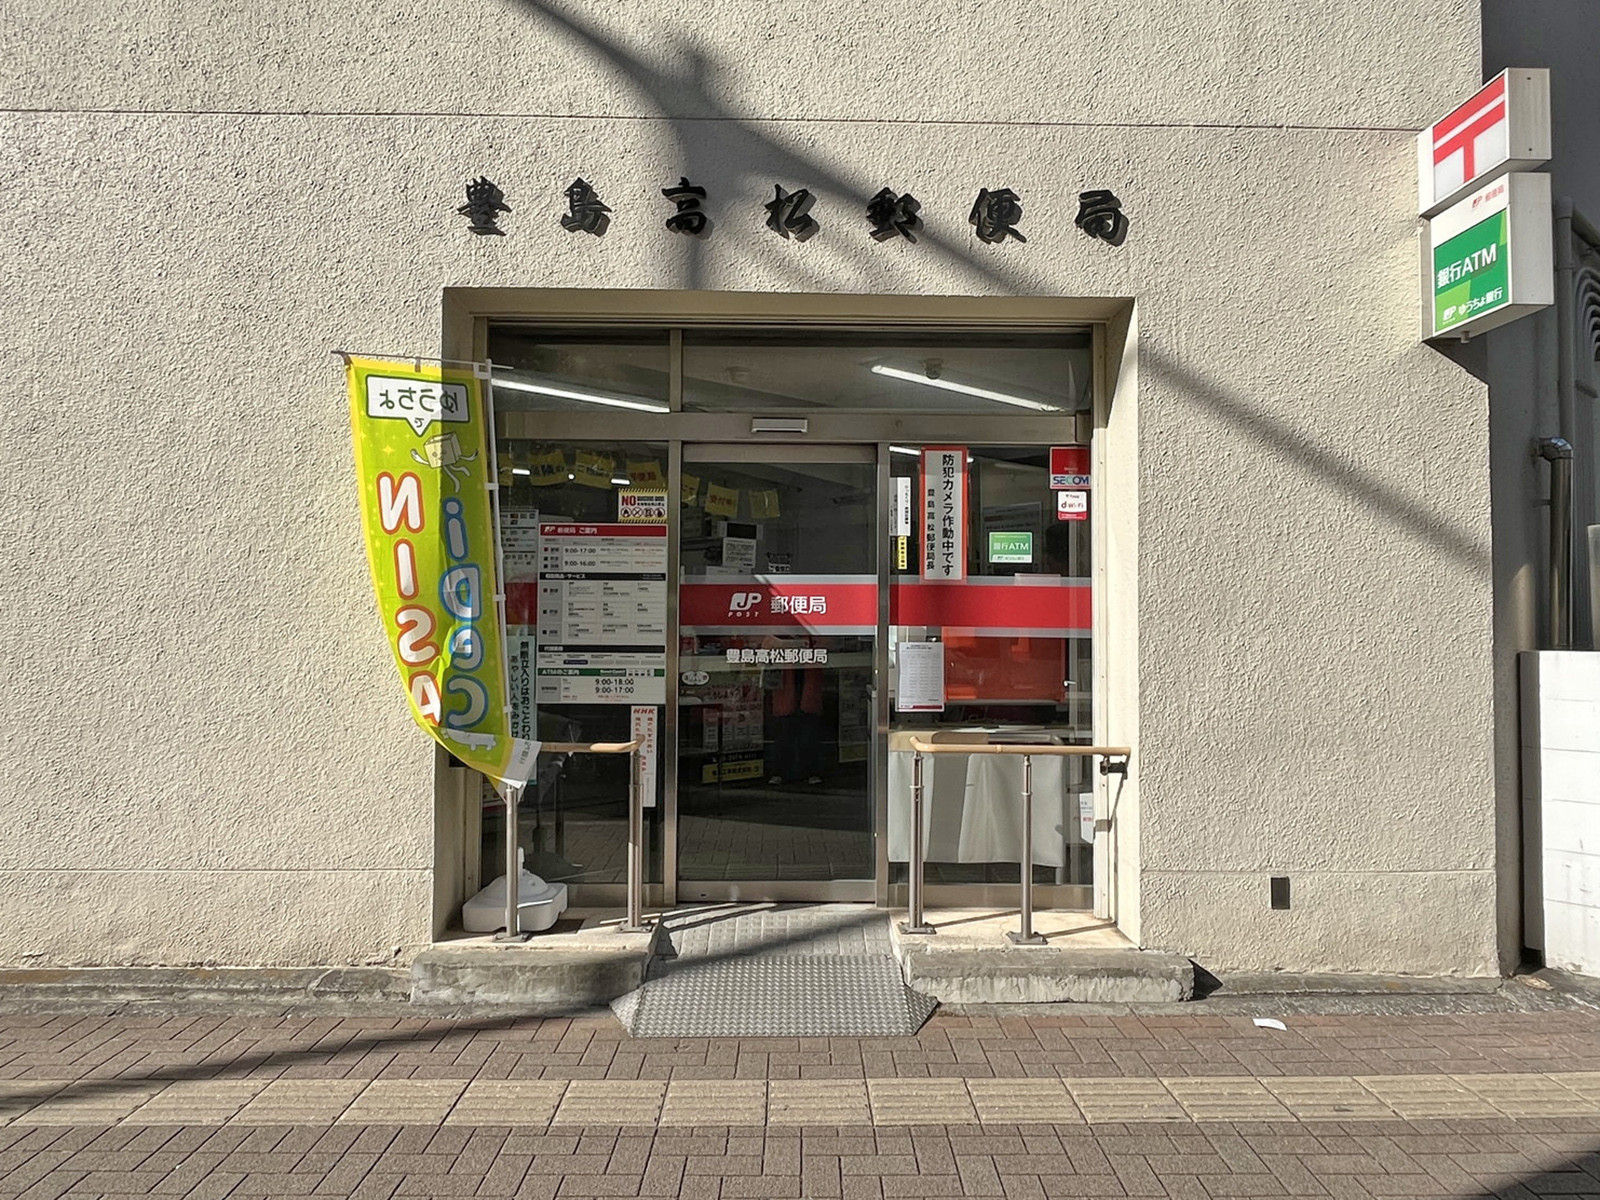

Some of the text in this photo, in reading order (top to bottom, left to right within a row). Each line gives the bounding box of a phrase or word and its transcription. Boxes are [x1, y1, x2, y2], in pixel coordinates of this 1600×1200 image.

[1437, 243, 1497, 289] 銀行ATM
[1458, 287, 1503, 316] ゆうちょ銀行
[1053, 476, 1089, 485] SECOM
[621, 495, 636, 506] NO
[942, 454, 954, 576] 防犯カメラ作動中です
[770, 595, 827, 614] 郵便局
[726, 648, 828, 664] 豊島高松郵便局
[595, 678, 634, 686] 9:00-18:00
[595, 686, 634, 694] 9:00-17:00
